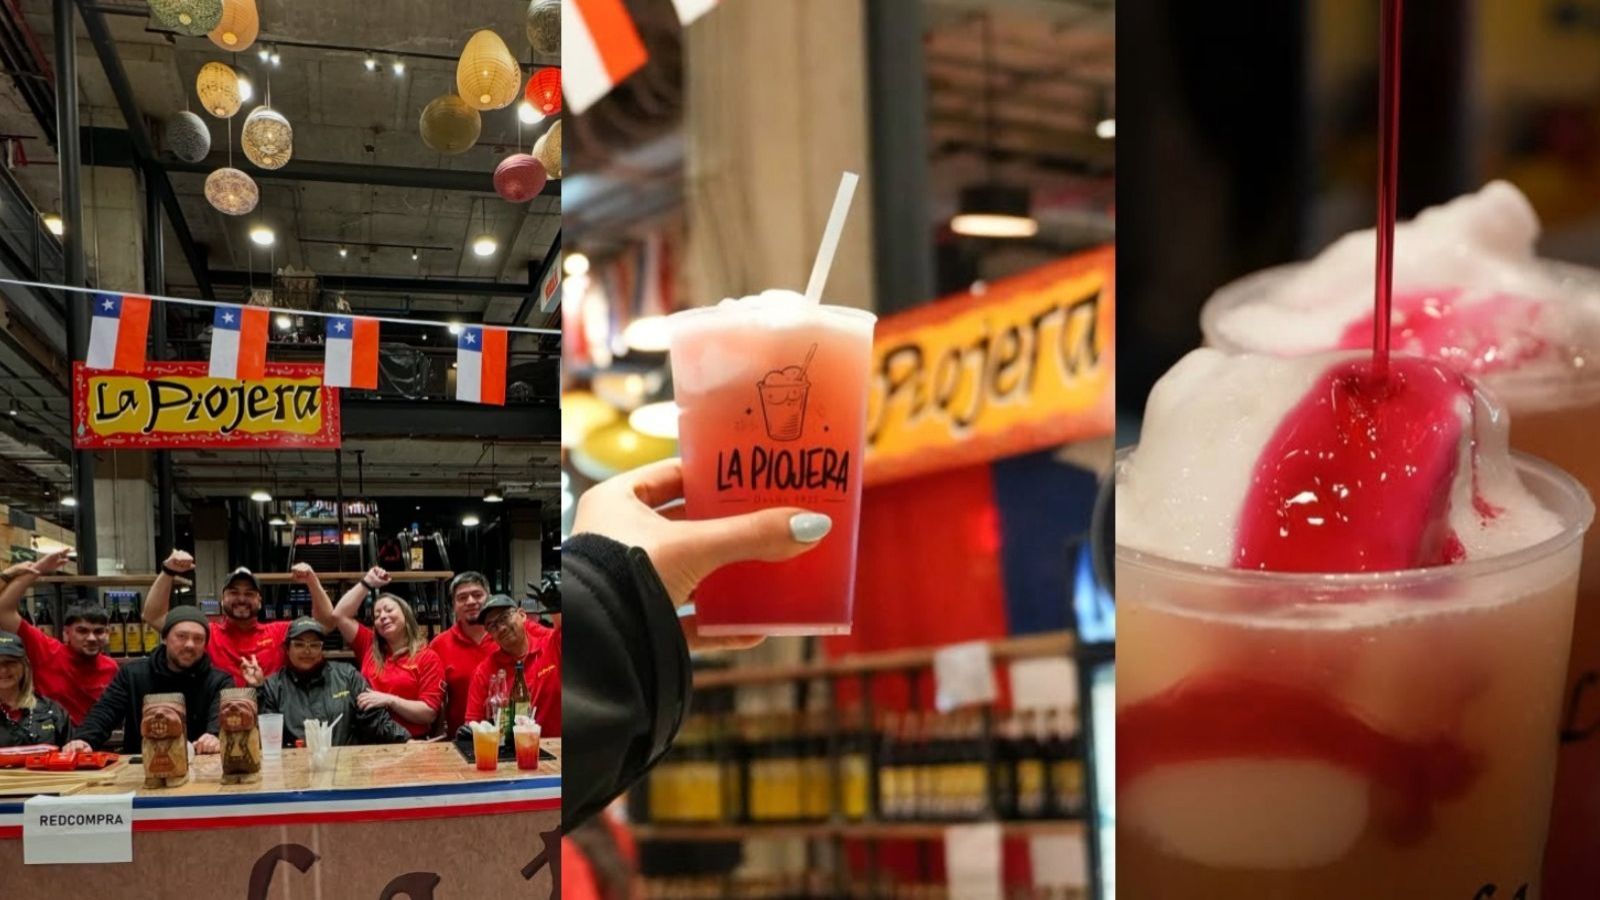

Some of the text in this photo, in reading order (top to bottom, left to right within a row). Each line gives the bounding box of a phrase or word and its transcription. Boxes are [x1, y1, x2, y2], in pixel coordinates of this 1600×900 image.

[95, 379, 321, 433] La Piojera
[717, 445, 850, 494] LA PIOJERA
[39, 814, 124, 826] REDCOMPRA
